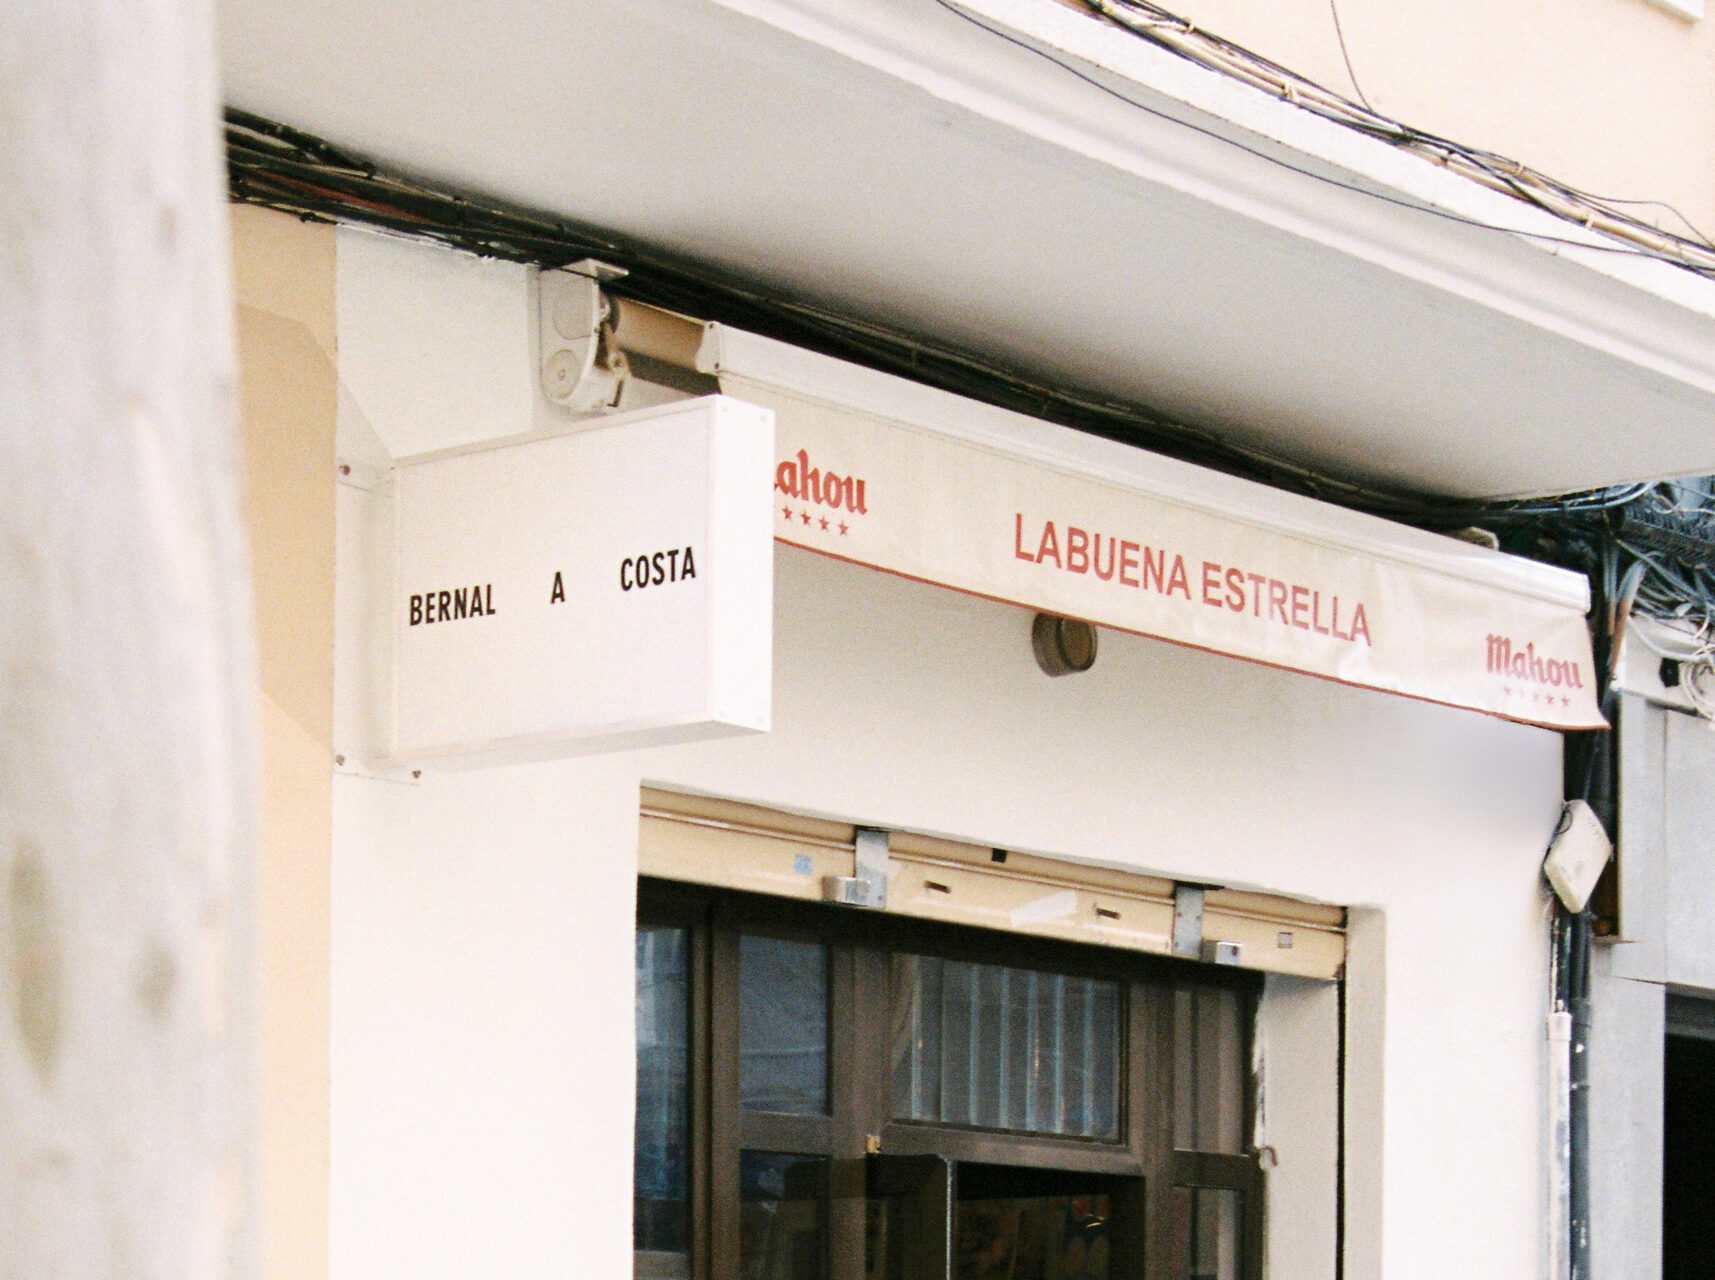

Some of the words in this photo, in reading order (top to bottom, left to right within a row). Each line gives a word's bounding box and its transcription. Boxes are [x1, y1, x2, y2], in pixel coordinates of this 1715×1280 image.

[774, 449, 868, 515] ahou
[410, 584, 496, 626] BERNAL
[550, 571, 565, 604] A
[620, 546, 696, 592] COSTA
[1202, 561, 1372, 646] ESTRELLA
[1485, 633, 1584, 689] Mahou
